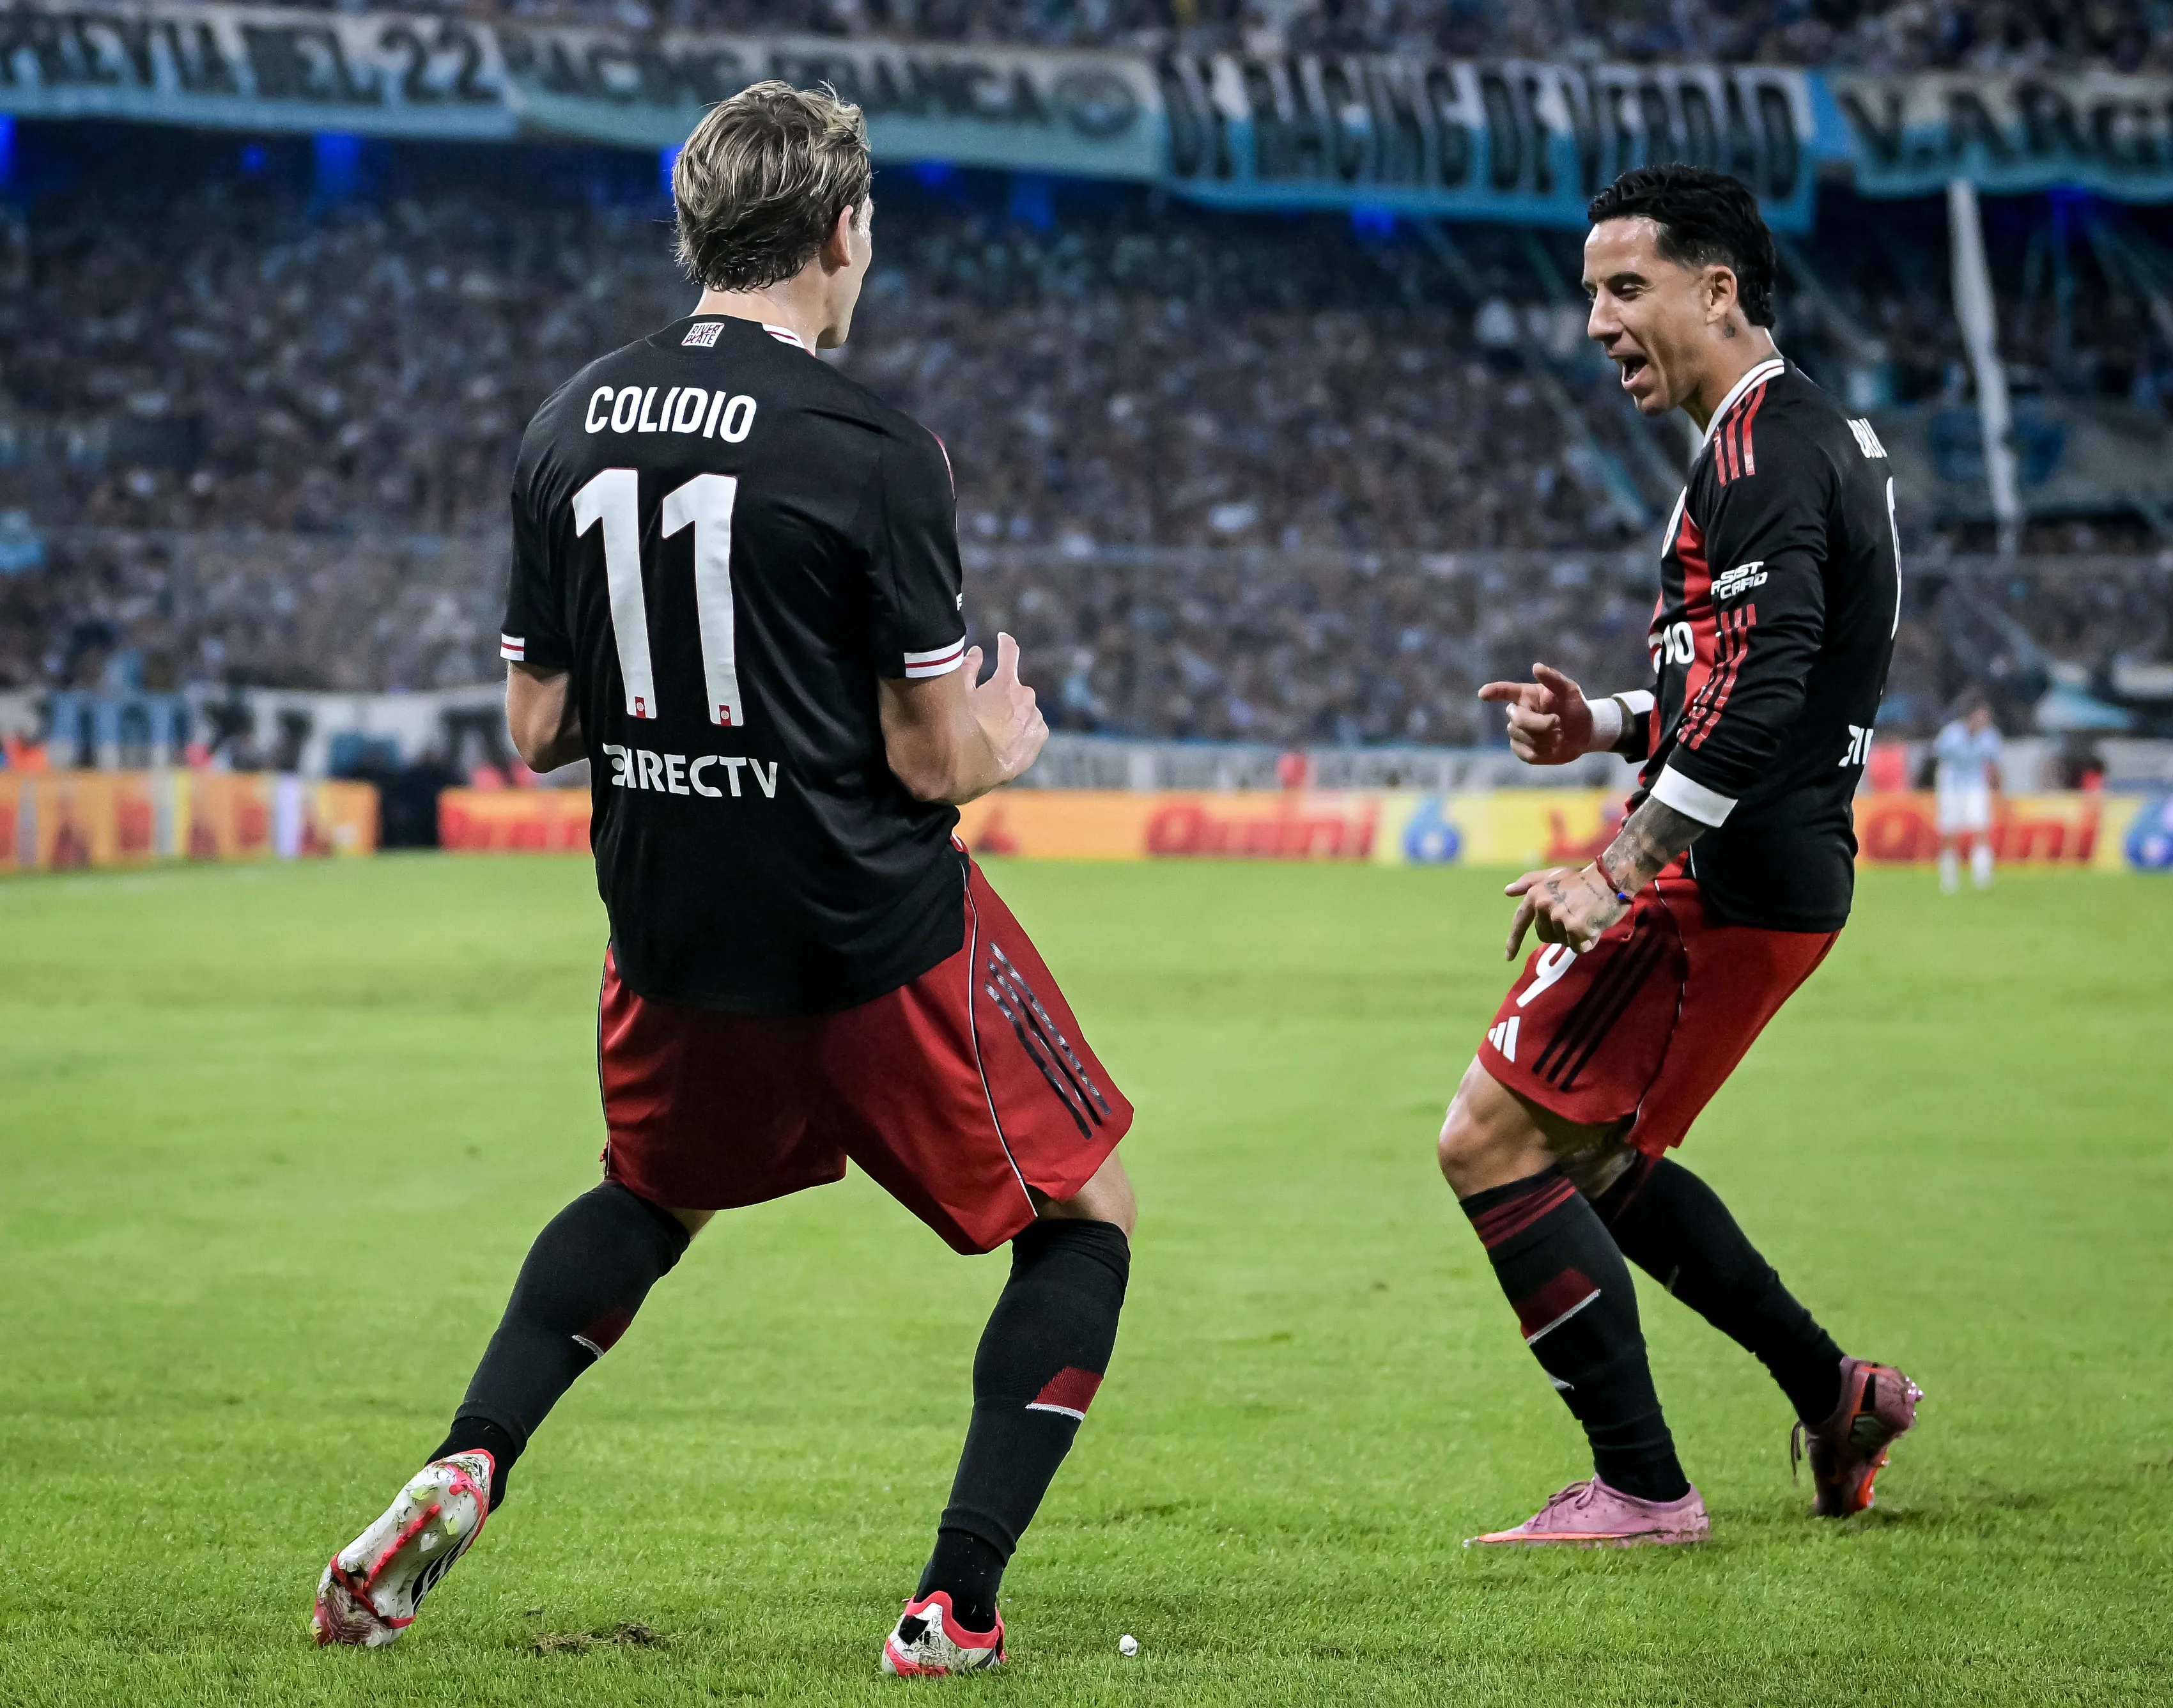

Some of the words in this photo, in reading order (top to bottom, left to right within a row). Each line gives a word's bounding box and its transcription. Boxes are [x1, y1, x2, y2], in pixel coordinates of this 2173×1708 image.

[685, 334, 716, 345] PLATE
[691, 324, 720, 335] RIVER
[584, 385, 757, 443] COLIDIO
[572, 467, 745, 727] 11
[1720, 571, 1768, 600] CARD
[603, 742, 778, 799] DIRECTV
